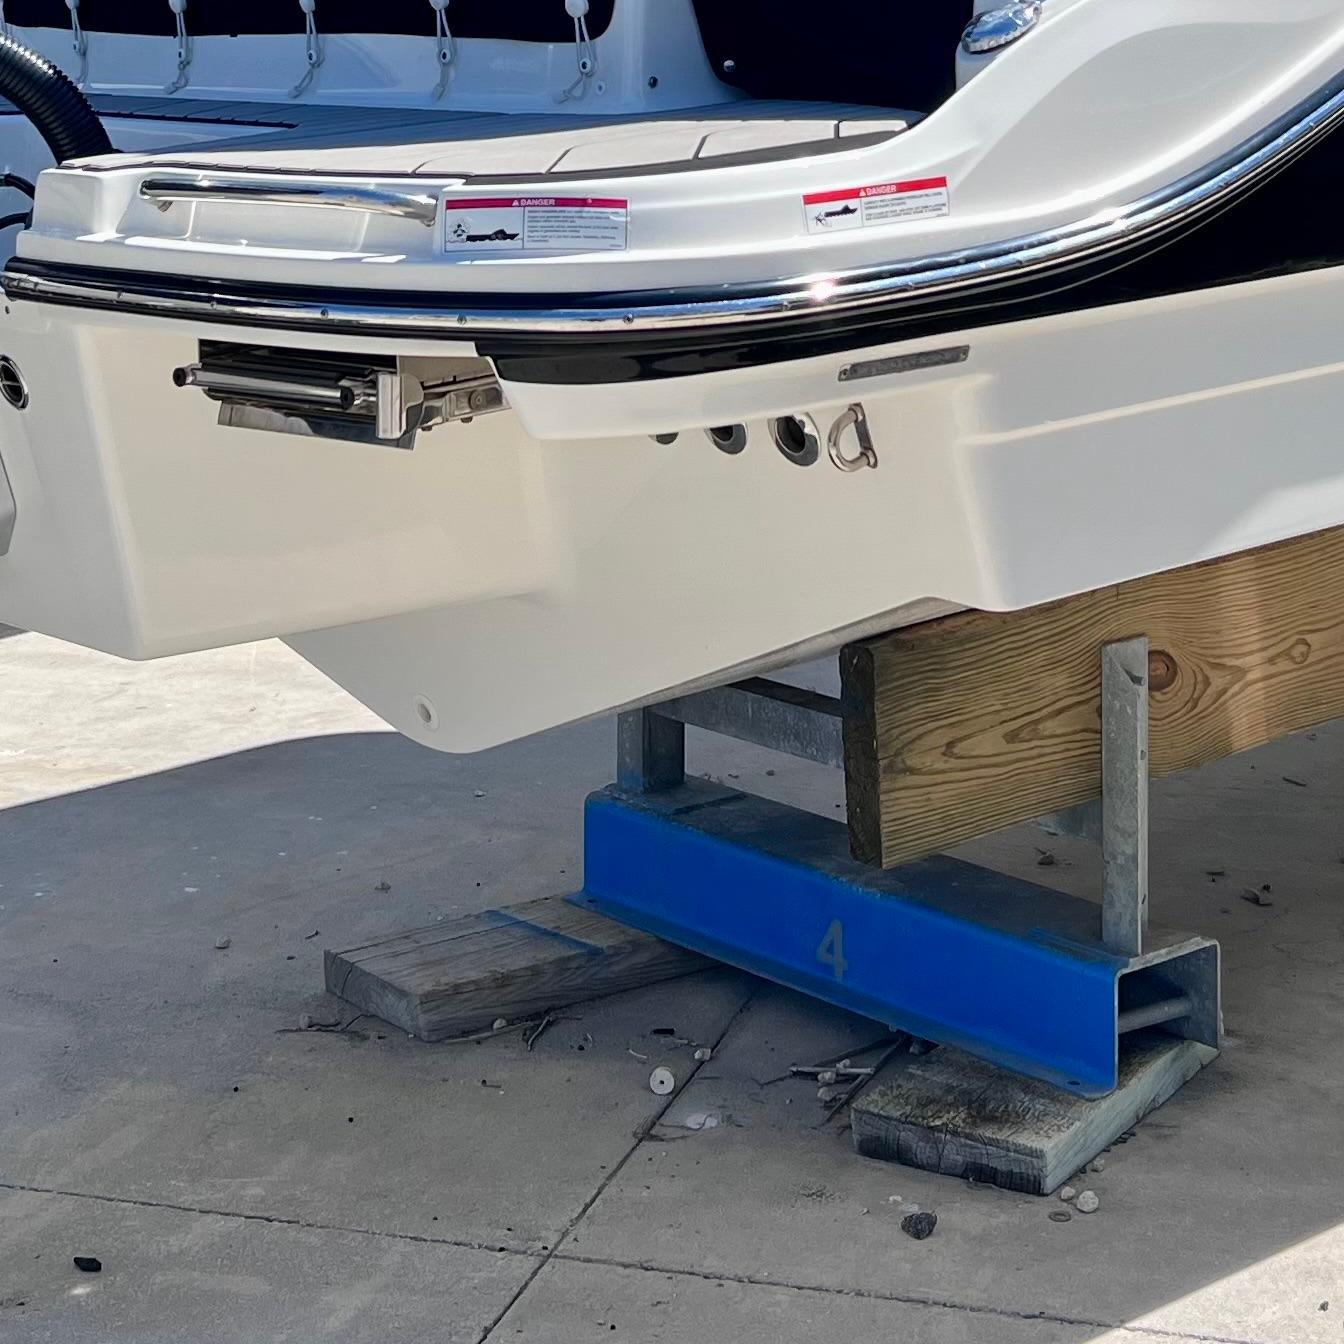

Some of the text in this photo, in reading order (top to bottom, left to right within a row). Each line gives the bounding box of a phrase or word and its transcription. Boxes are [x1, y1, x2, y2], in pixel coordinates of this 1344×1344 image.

[866, 184, 897, 196] DANGER
[520, 198, 556, 207] DANGER
[816, 919, 849, 984] 4
